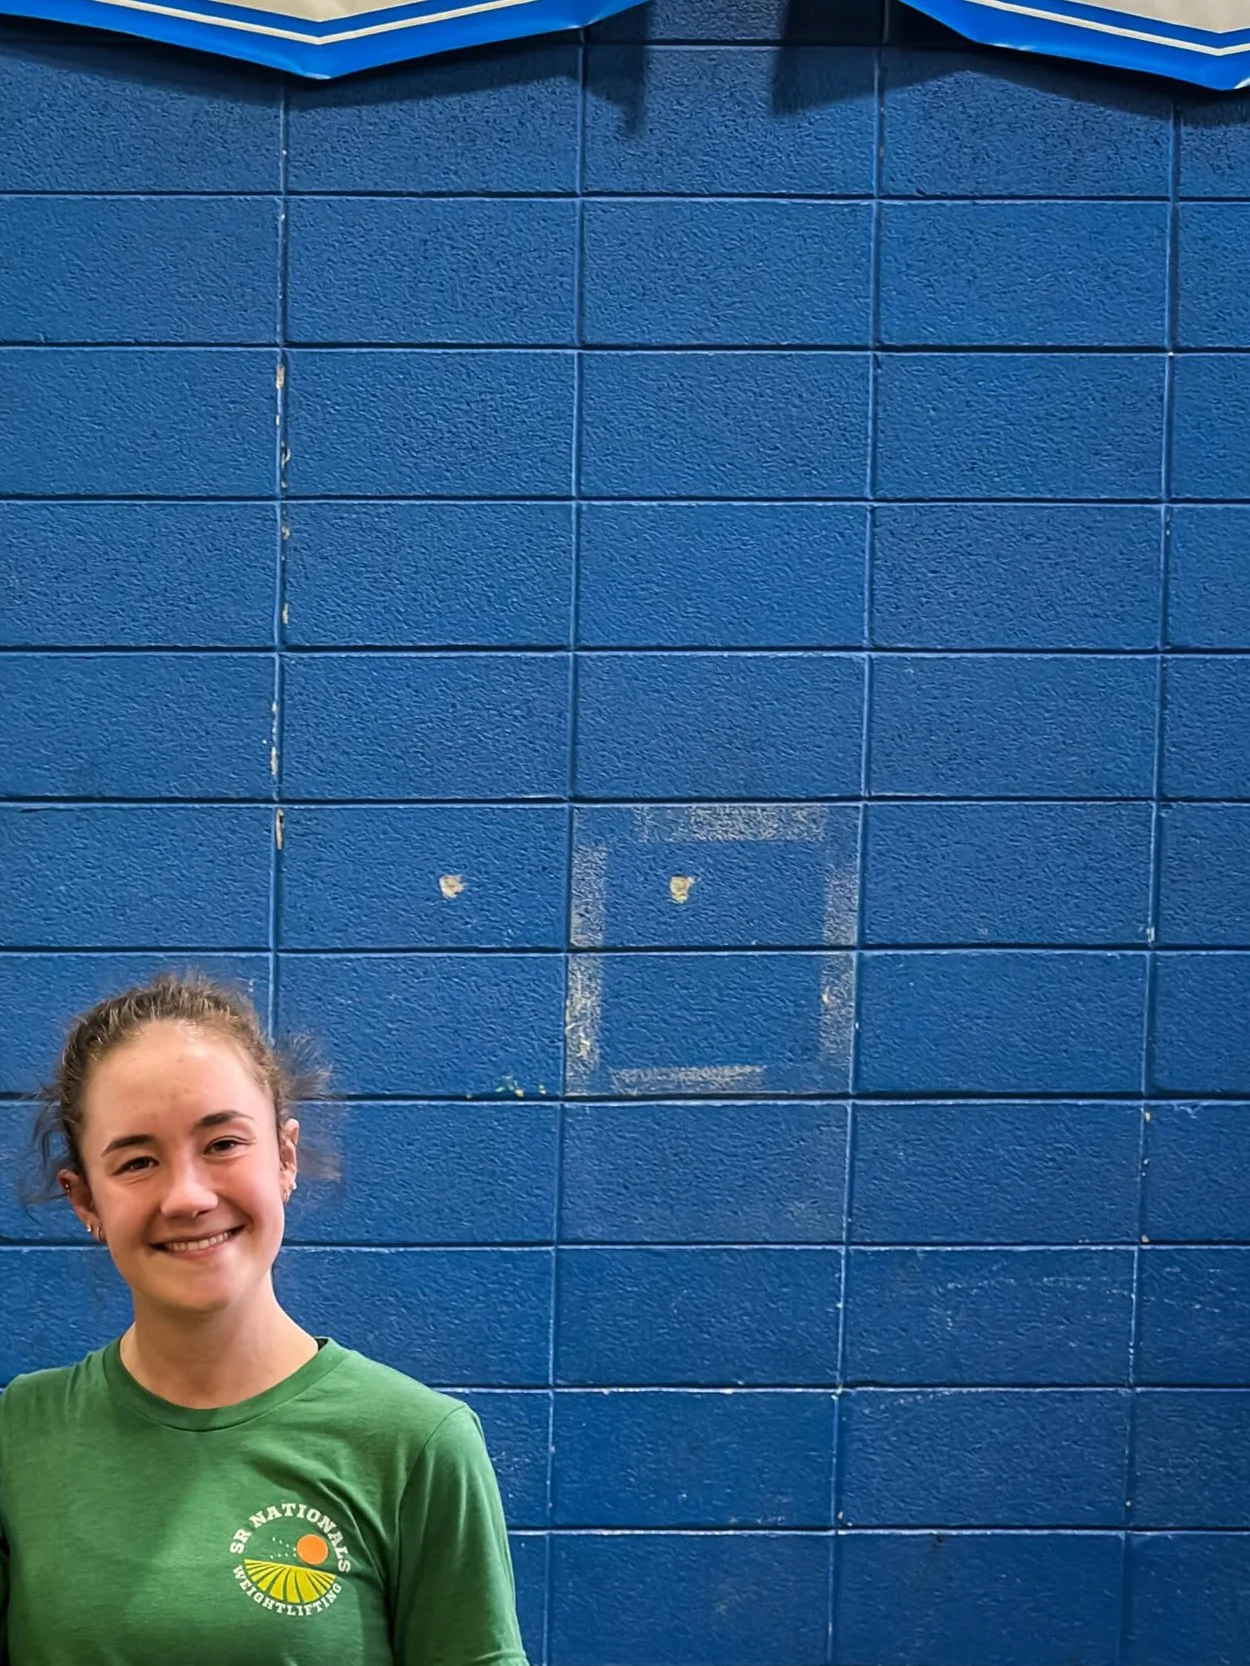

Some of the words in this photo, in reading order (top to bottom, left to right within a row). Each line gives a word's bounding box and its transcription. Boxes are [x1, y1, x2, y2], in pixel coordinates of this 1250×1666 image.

[230, 1528, 252, 1554] SR
[248, 1503, 351, 1573] NATIONALS
[232, 1565, 342, 1616] WEIGHTLIFTING
